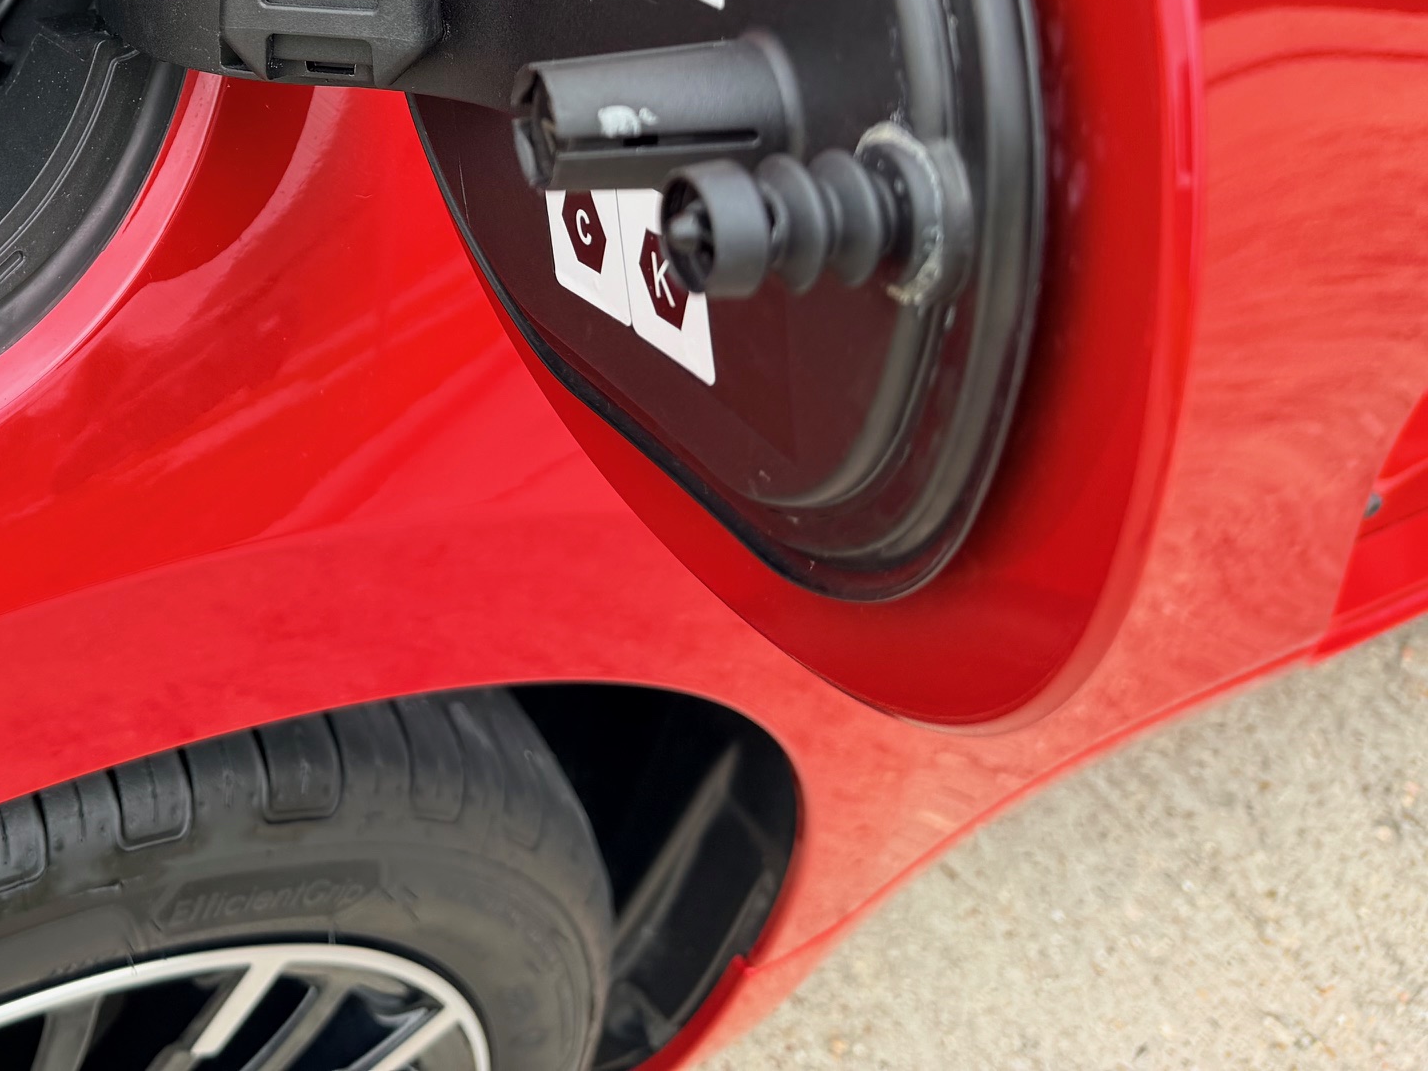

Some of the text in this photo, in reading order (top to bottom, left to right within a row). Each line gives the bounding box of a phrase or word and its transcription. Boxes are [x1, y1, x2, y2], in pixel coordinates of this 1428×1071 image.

[576, 209, 592, 246] C
[651, 251, 676, 308] K
[169, 878, 364, 926] EfficientGrip
